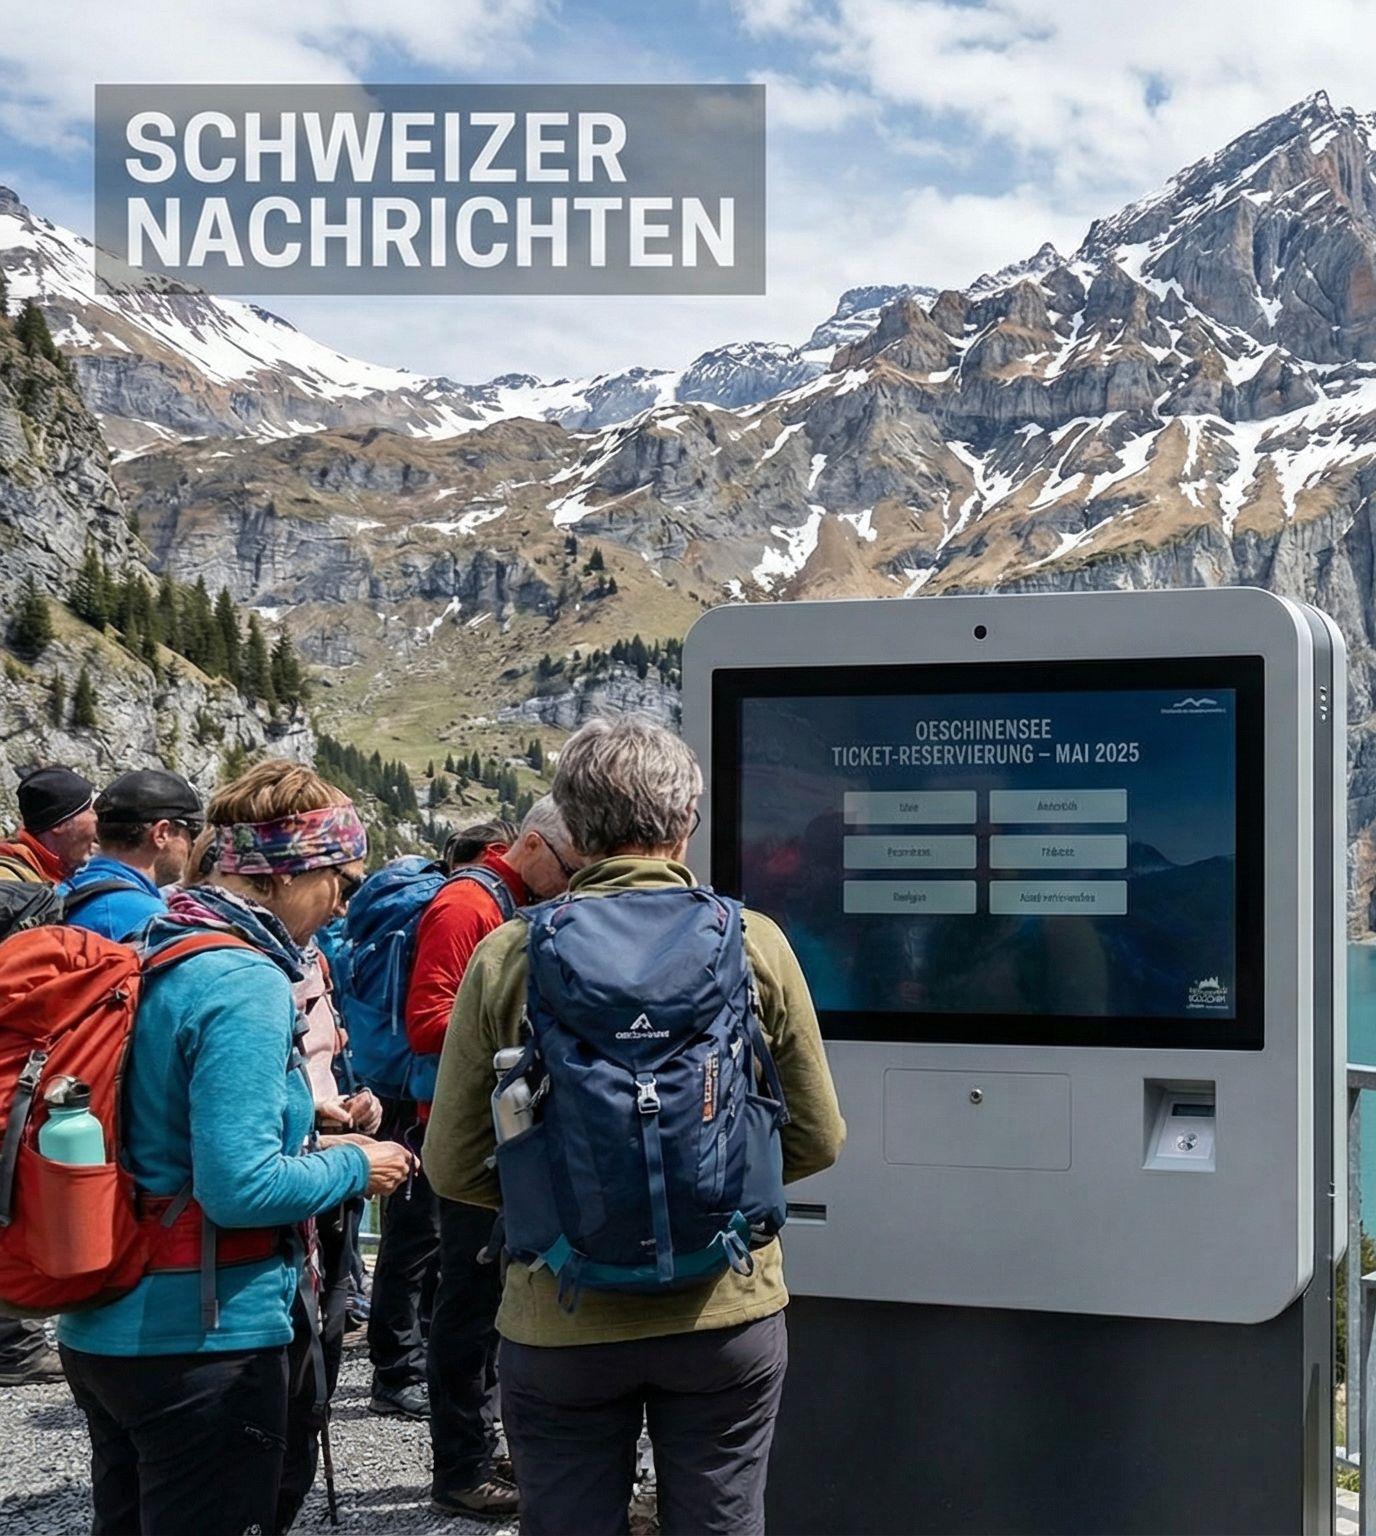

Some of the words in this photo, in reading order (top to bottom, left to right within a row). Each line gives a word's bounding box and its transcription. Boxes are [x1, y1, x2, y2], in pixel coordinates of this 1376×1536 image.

[915, 719, 1052, 741] OESCHINENSEE
[832, 744, 1034, 766] TICKET-RESERVIERUNG
[1056, 743, 1089, 764] MAI
[1095, 743, 1140, 763] 2025
